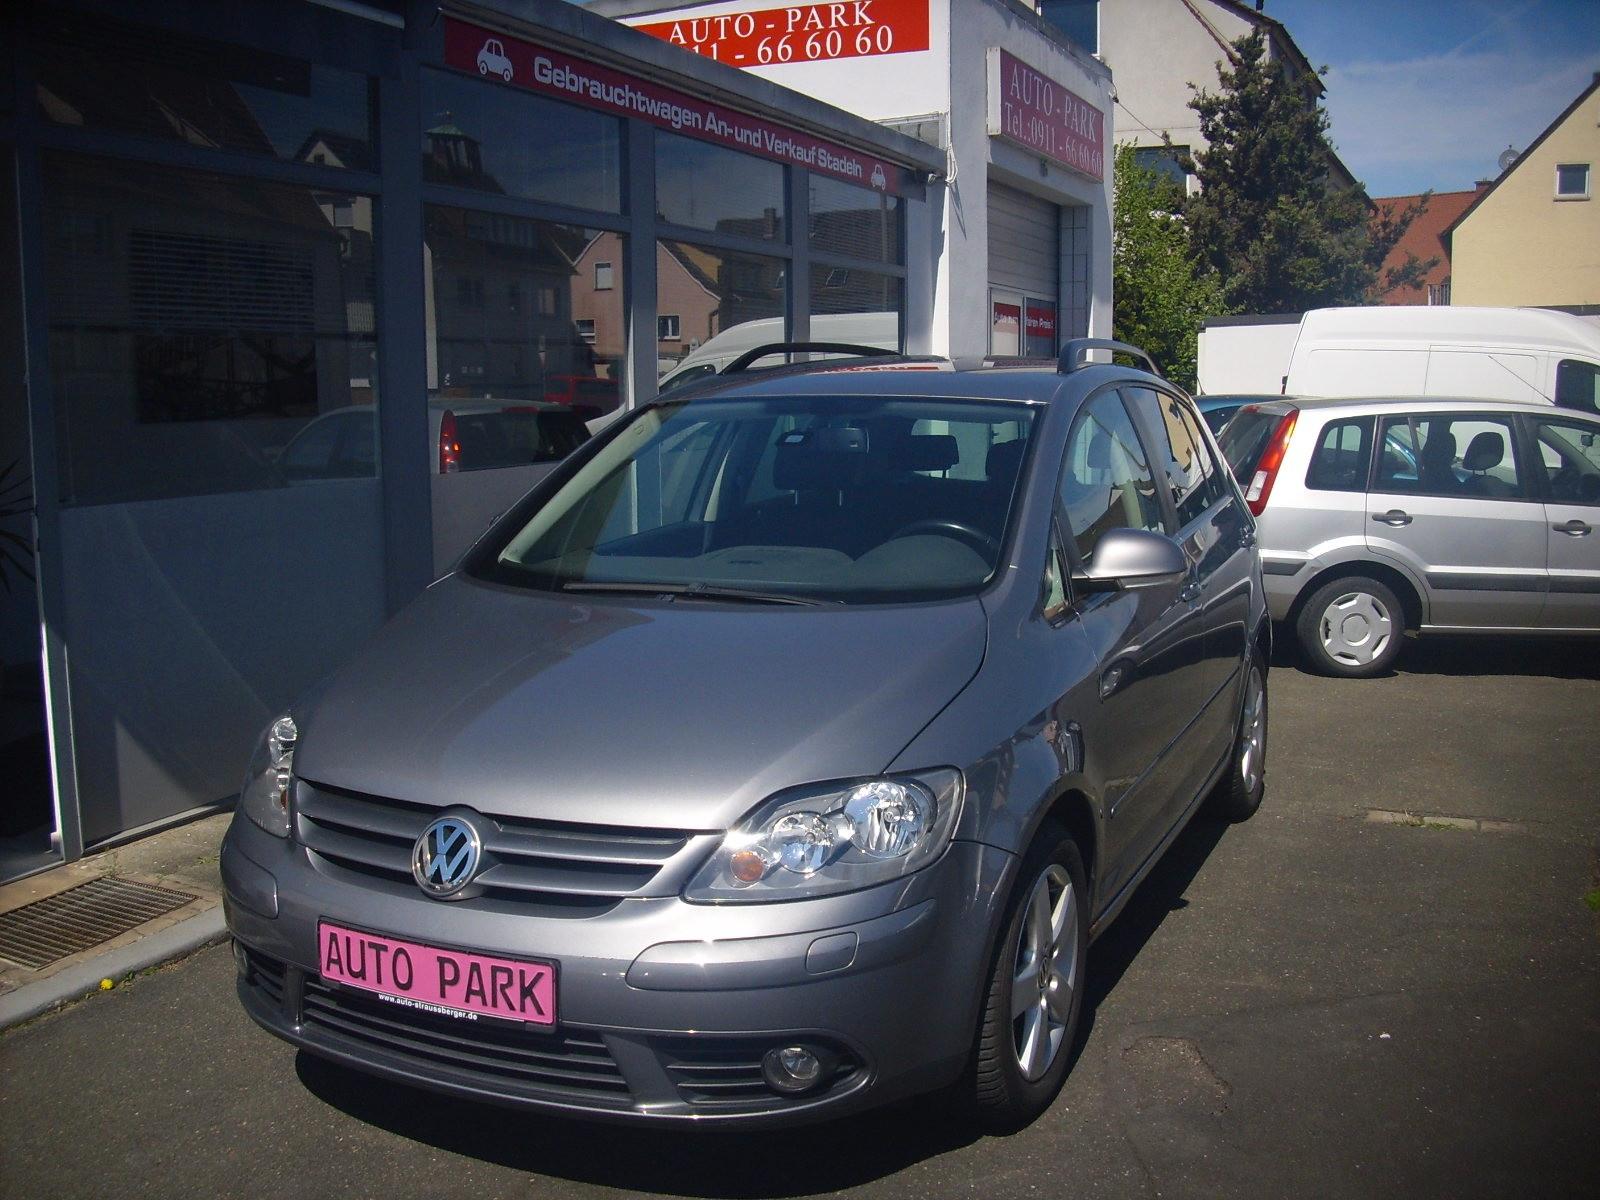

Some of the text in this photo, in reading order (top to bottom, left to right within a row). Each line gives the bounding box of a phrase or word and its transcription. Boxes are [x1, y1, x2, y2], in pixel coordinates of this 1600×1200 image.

[669, 14, 755, 45] AUTO
[786, 1, 875, 33] PARK
[757, 36, 793, 64] 66
[805, 30, 843, 59] 60
[855, 25, 893, 55] 60
[534, 56, 702, 129] Gebrauchtwagen
[764, 130, 816, 164] Verkauf
[817, 149, 862, 178] Stadeln
[1010, 63, 1053, 116] AUTO
[1064, 95, 1096, 143] PARK
[326, 931, 545, 1016] AUTO PARK
[378, 993, 478, 1020] www.auto-straussberger.de
